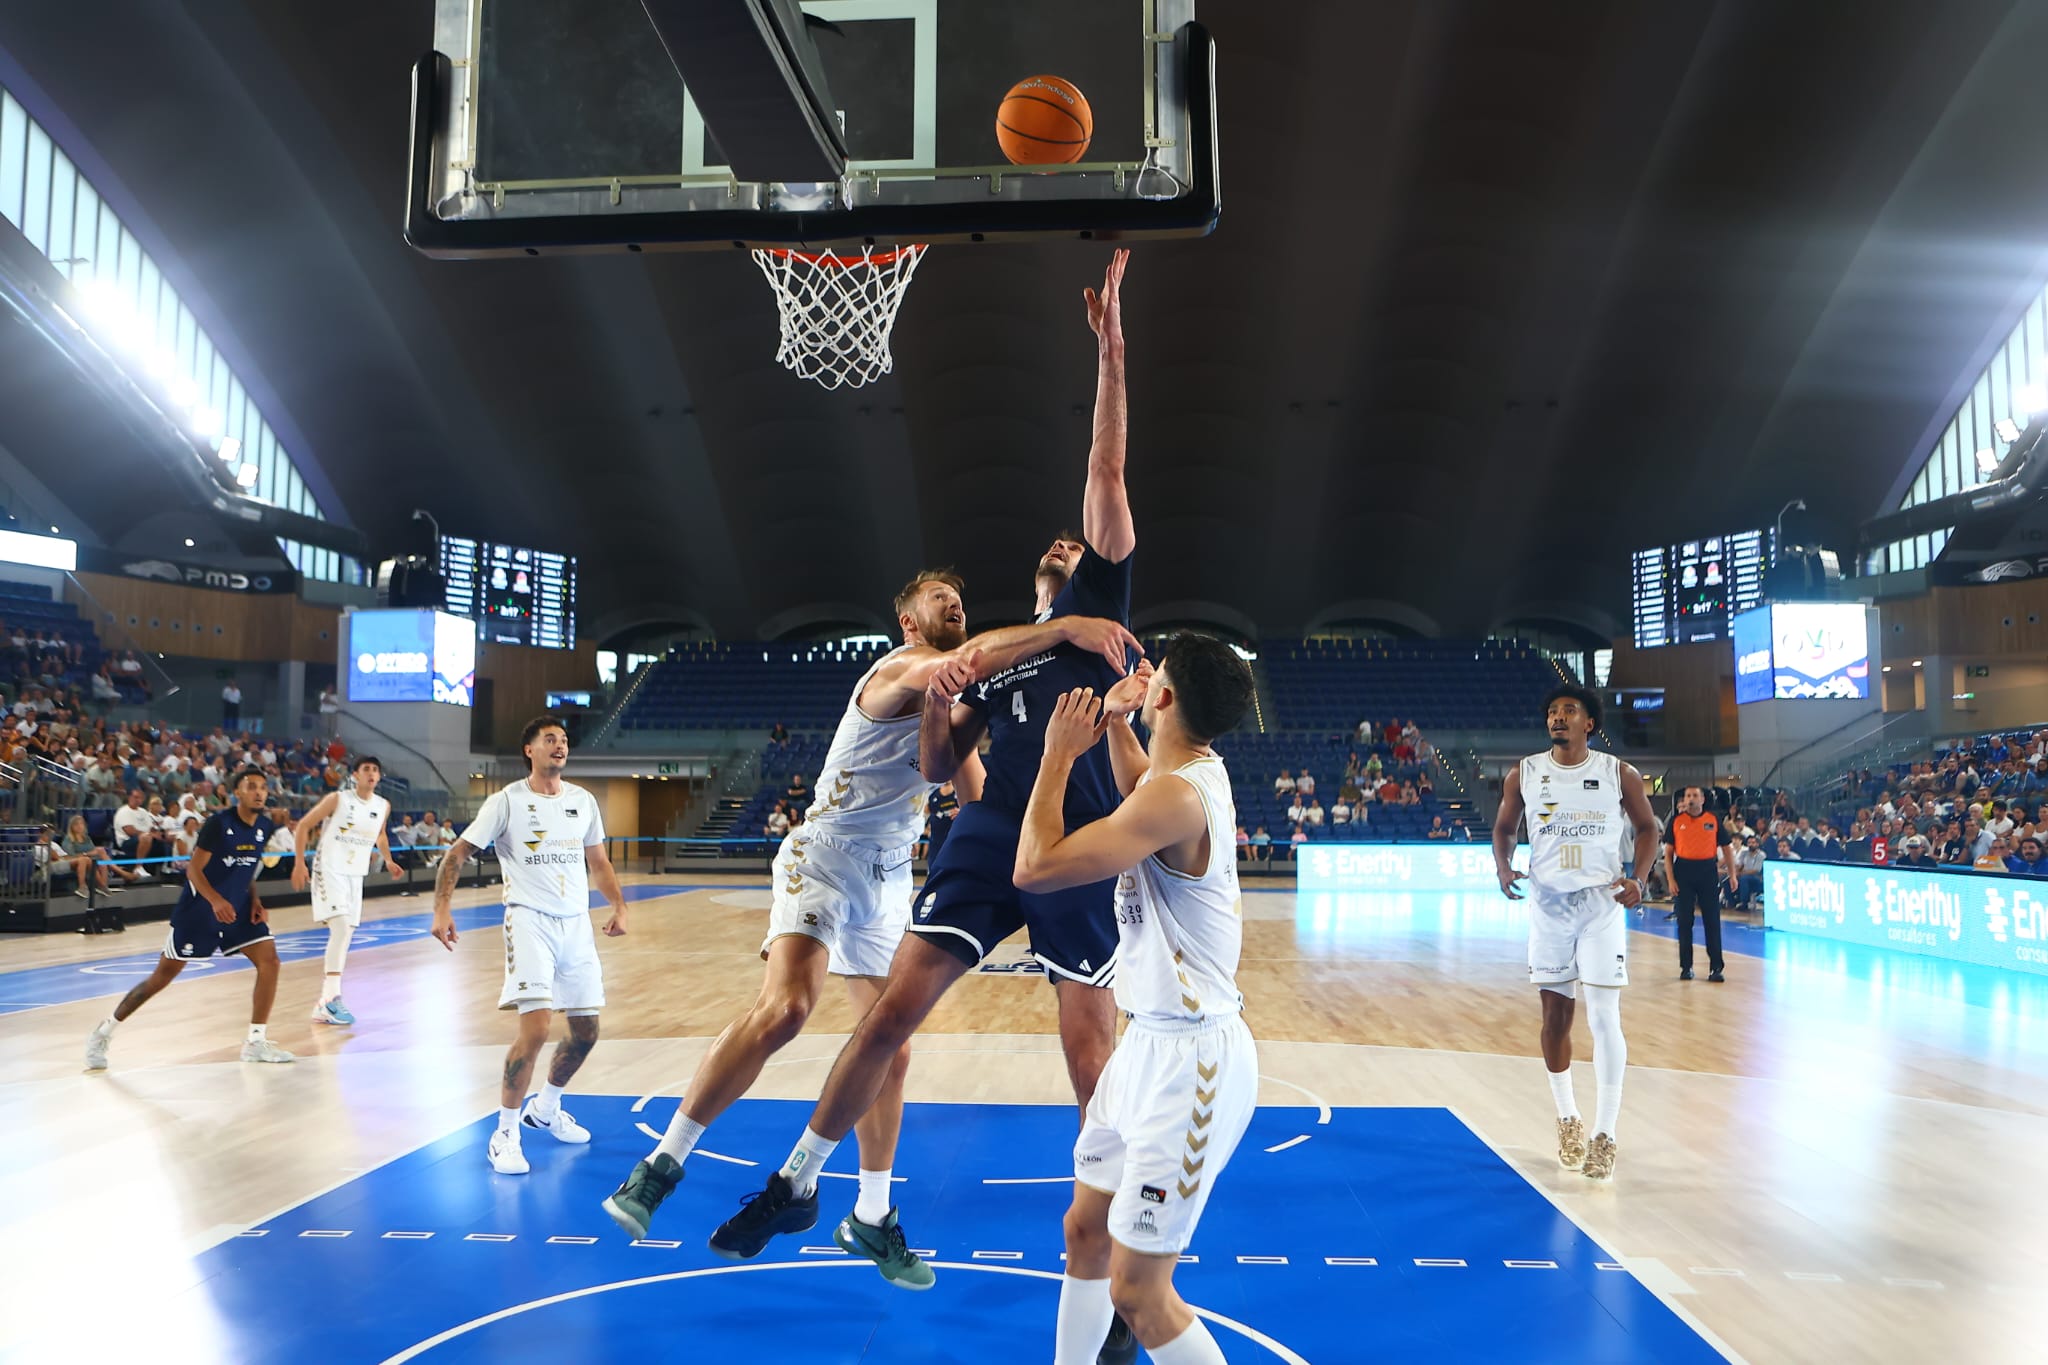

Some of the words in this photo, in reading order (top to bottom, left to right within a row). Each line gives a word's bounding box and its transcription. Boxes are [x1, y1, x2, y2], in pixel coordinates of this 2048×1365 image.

[1004, 668, 1039, 687] ASTURIAS
[1011, 690, 1028, 723] 4
[533, 853, 580, 866] BURGOS
[1874, 842, 1886, 861] 5
[1336, 850, 1412, 881] Enerthy
[1788, 870, 1845, 924] Enerthy
[1127, 904, 1142, 914] 20
[1130, 914, 1144, 924] 31
[1885, 879, 1962, 940] Enerthy
[2013, 890, 2048, 940] En
[1888, 926, 1938, 947] consultores
[1142, 1190, 1160, 1201] acb
